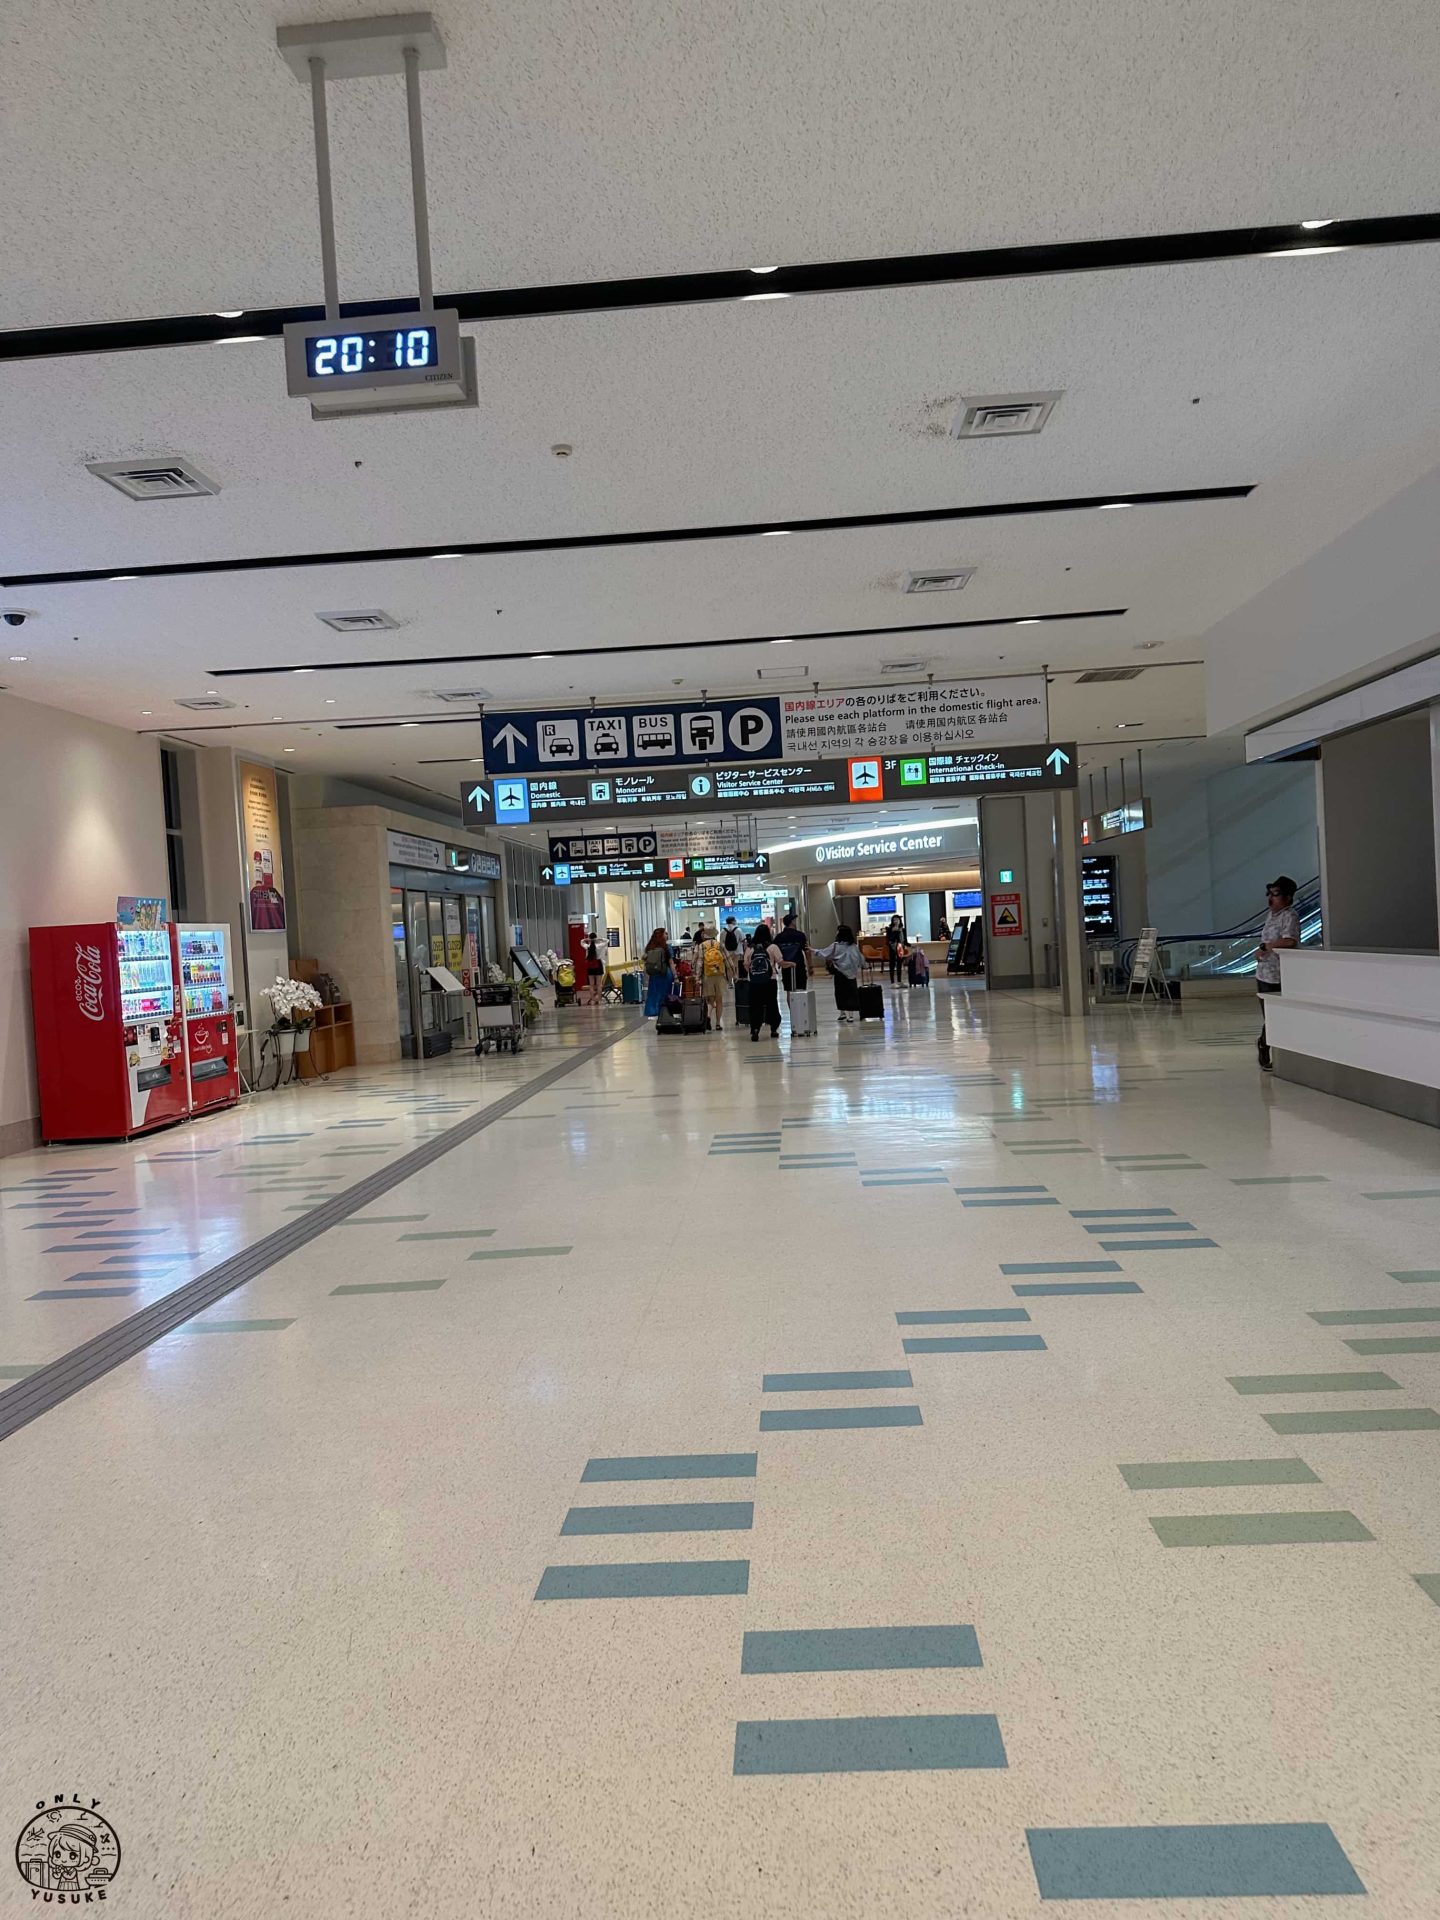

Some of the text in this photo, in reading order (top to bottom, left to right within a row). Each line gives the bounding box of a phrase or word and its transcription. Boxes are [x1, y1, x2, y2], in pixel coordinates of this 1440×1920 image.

[315, 330, 429, 375] 20:10
[424, 372, 453, 382] CITIZEN
[784, 688, 985, 712] 国内線エリアの各のりばをご利用ください。
[785, 697, 1041, 724] Please use each platform in the domestic flight area.
[588, 719, 622, 731] TAXI
[639, 717, 668, 728] BUS
[740, 714, 764, 746] P
[787, 729, 975, 752] 국내선 지역의 각 승강장을 이용하십시오
[955, 753, 999, 763] チェックイン
[884, 760, 897, 770] 3F
[928, 762, 1005, 774] International Check-in
[716, 767, 812, 780] ビジターサービスセンター
[530, 781, 558, 792] 国内線
[615, 775, 655, 787] モノレール
[717, 778, 784, 789] Visitor Service Center
[530, 791, 561, 799] Domestic
[615, 785, 646, 794] Monorail
[643, 839, 652, 851] P
[825, 835, 943, 860] Visitor Service Center
[75, 942, 105, 1021] Coca-Cola
